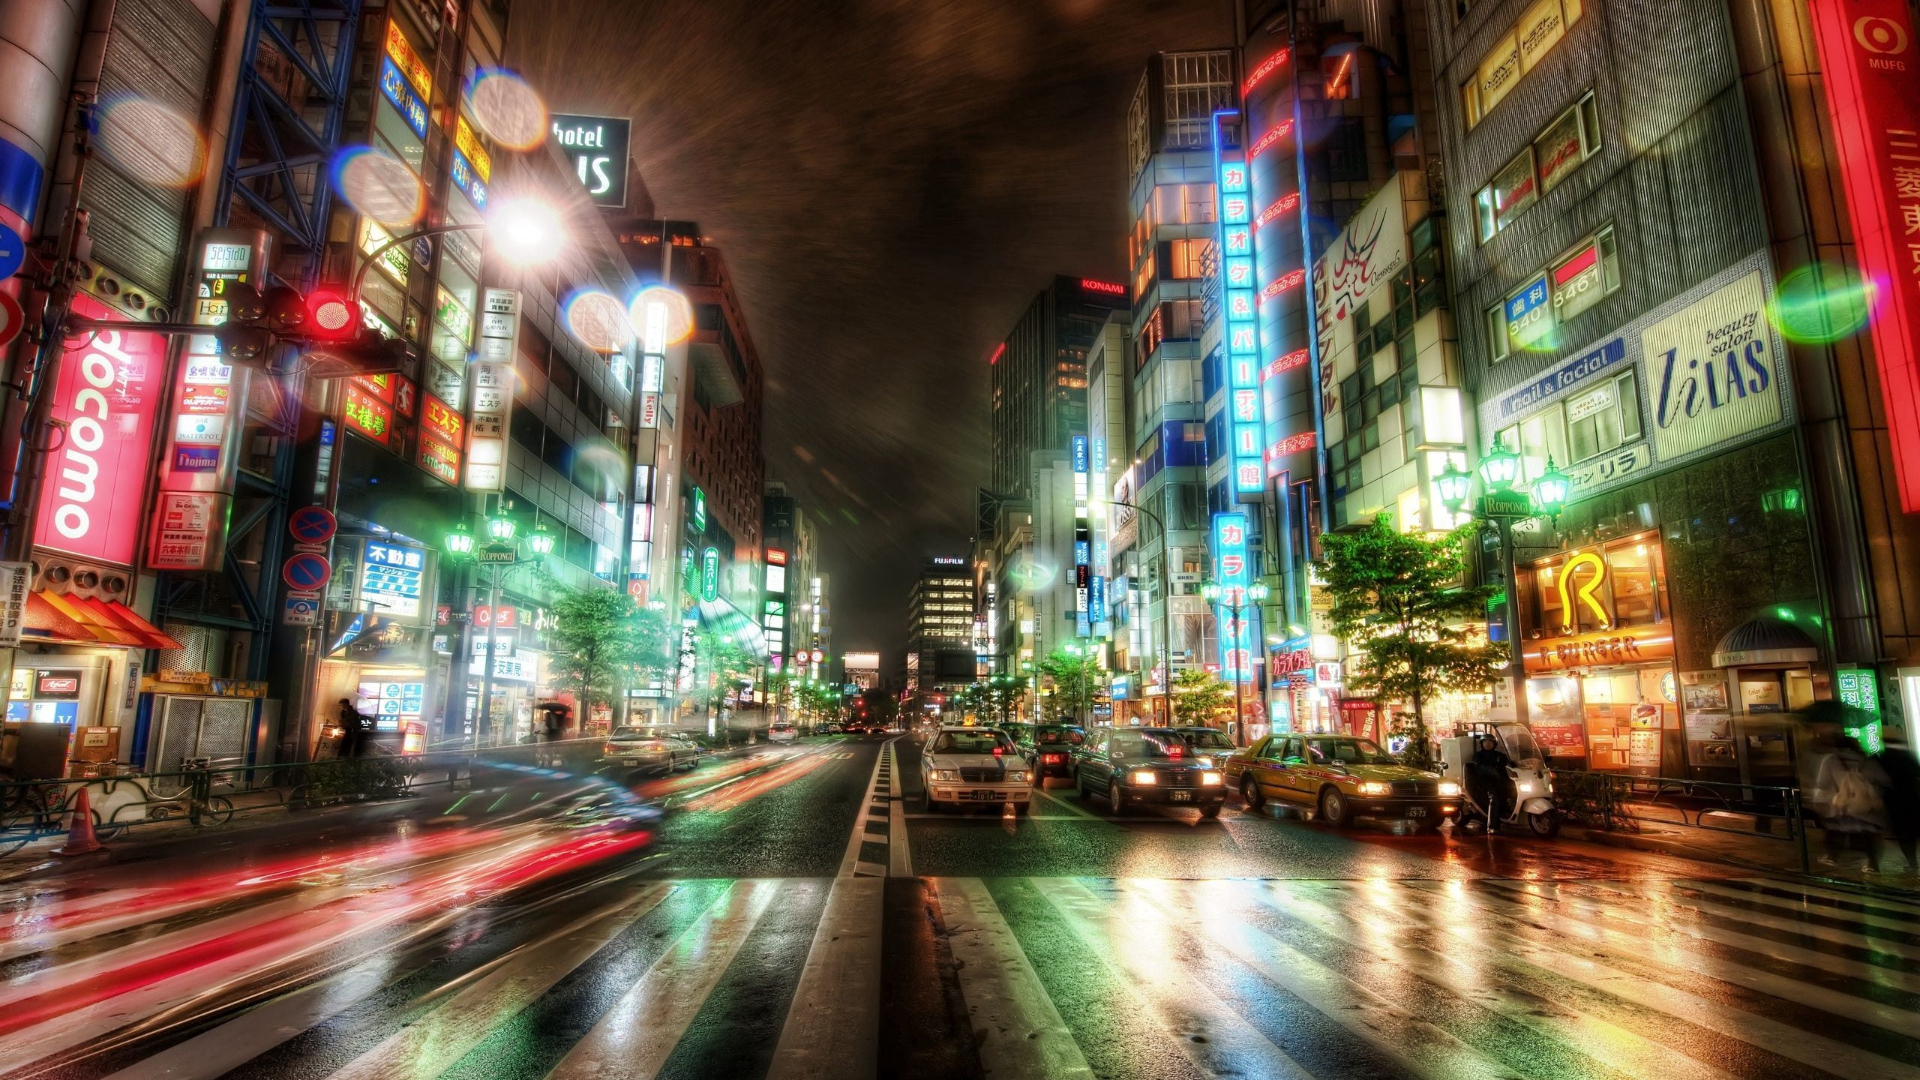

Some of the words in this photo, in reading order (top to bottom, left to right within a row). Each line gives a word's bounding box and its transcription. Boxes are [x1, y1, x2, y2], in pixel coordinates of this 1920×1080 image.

[1868, 58, 1906, 71] MUFG
[552, 122, 604, 148] hotel
[1082, 279, 1124, 295] KONAMI
[1510, 302, 1550, 336] 3401
[1553, 267, 1599, 308] 8461
[1512, 285, 1544, 318] 歯科
[1312, 255, 1338, 419] オリエンタル
[1705, 310, 1758, 345] beauty
[1710, 328, 1754, 358] salon
[1510, 385, 1542, 412] nail
[1544, 382, 1555, 395] &
[1556, 348, 1608, 389] facial
[429, 401, 461, 434] エステ
[642, 395, 655, 425] Kelly
[54, 318, 132, 540] docomo
[1600, 452, 1637, 479] リラ
[369, 545, 421, 569] 不動産
[934, 557, 964, 565] FUJIFILM
[706, 558, 716, 599] モスバーガー
[1221, 525, 1251, 671] カラオケ館
[475, 641, 507, 650] DRGS
[1555, 635, 1640, 662] BURGER
[1840, 673, 1861, 708] 歯科
